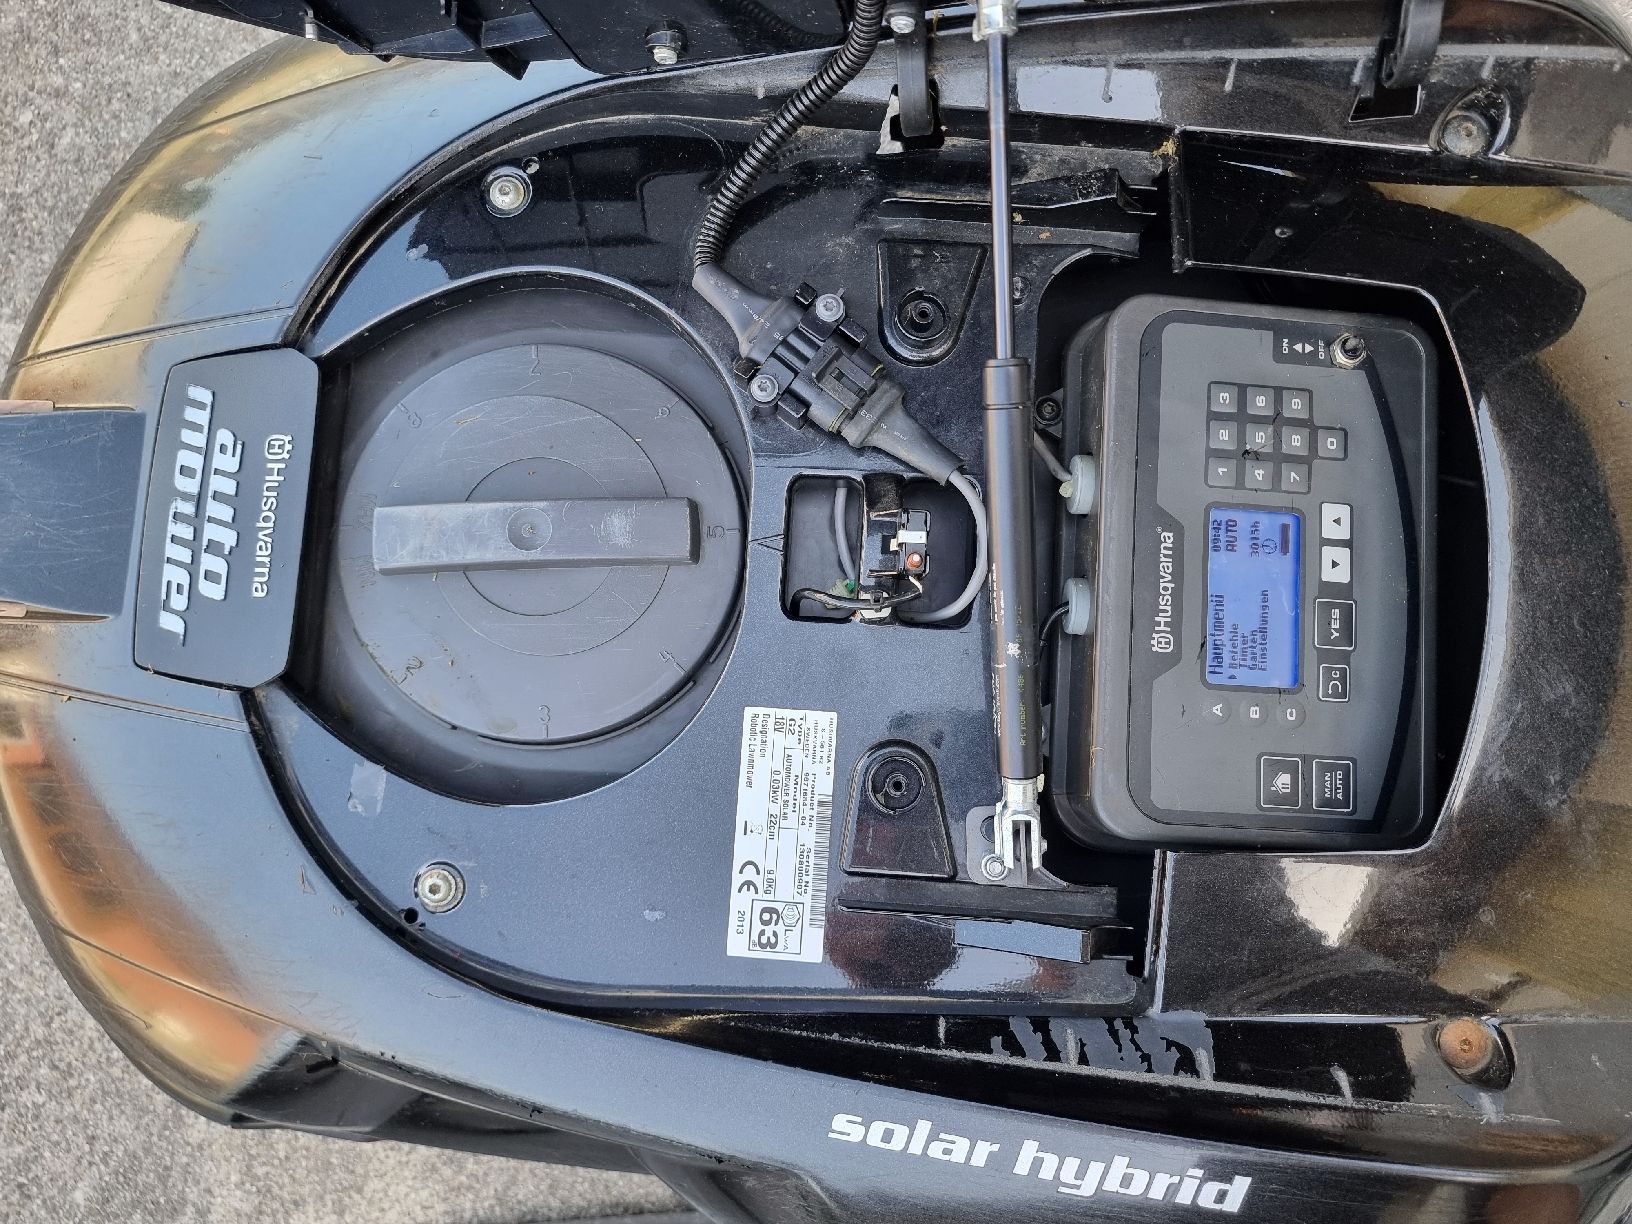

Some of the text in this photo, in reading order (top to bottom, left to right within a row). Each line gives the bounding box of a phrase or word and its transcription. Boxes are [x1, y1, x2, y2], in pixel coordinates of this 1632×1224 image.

[1282, 339, 1289, 353] ON
[1219, 392, 1230, 404] 3
[1256, 395, 1265, 407] 6
[1291, 398, 1302, 409] 9
[1219, 429, 1229, 440] 2
[1256, 431, 1265, 443] 5
[1291, 435, 1301, 447] 8
[1327, 438, 1336, 449] 0
[1218, 467, 1228, 475] 1
[1254, 468, 1264, 480] 4
[1290, 471, 1299, 483] 7
[159, 384, 214, 647] mower
[198, 428, 245, 601] auto
[252, 462, 285, 599] Husqvarna
[1212, 519, 1223, 553] 09:42
[1225, 518, 1238, 553] AUTO
[1154, 531, 1175, 631] Husqvarna
[1208, 594, 1226, 675] Hauptmenü
[1258, 590, 1269, 671] Einstellungen
[1330, 609, 1340, 639] YES
[1228, 623, 1239, 669] Befehle
[1239, 632, 1249, 669] Timer
[1248, 629, 1258, 671] Garten
[1332, 670, 1340, 678] C
[1212, 703, 1223, 717] A
[1250, 705, 1259, 719] B
[1286, 708, 1296, 721] C
[760, 713, 770, 758] Designation
[774, 716, 785, 733] 18V
[788, 718, 796, 735] G2
[746, 713, 759, 788] Robotic Lawnmower
[771, 770, 781, 804] 0.03kW
[782, 754, 792, 821] AUTOMOWER SOLAR
[768, 813, 778, 840] 22cm
[738, 860, 760, 894] CE
[764, 869, 774, 894] 9.0Kg
[736, 910, 745, 935] 2013
[758, 906, 780, 950] 63
[828, 1112, 1252, 1213] solar hybrid
